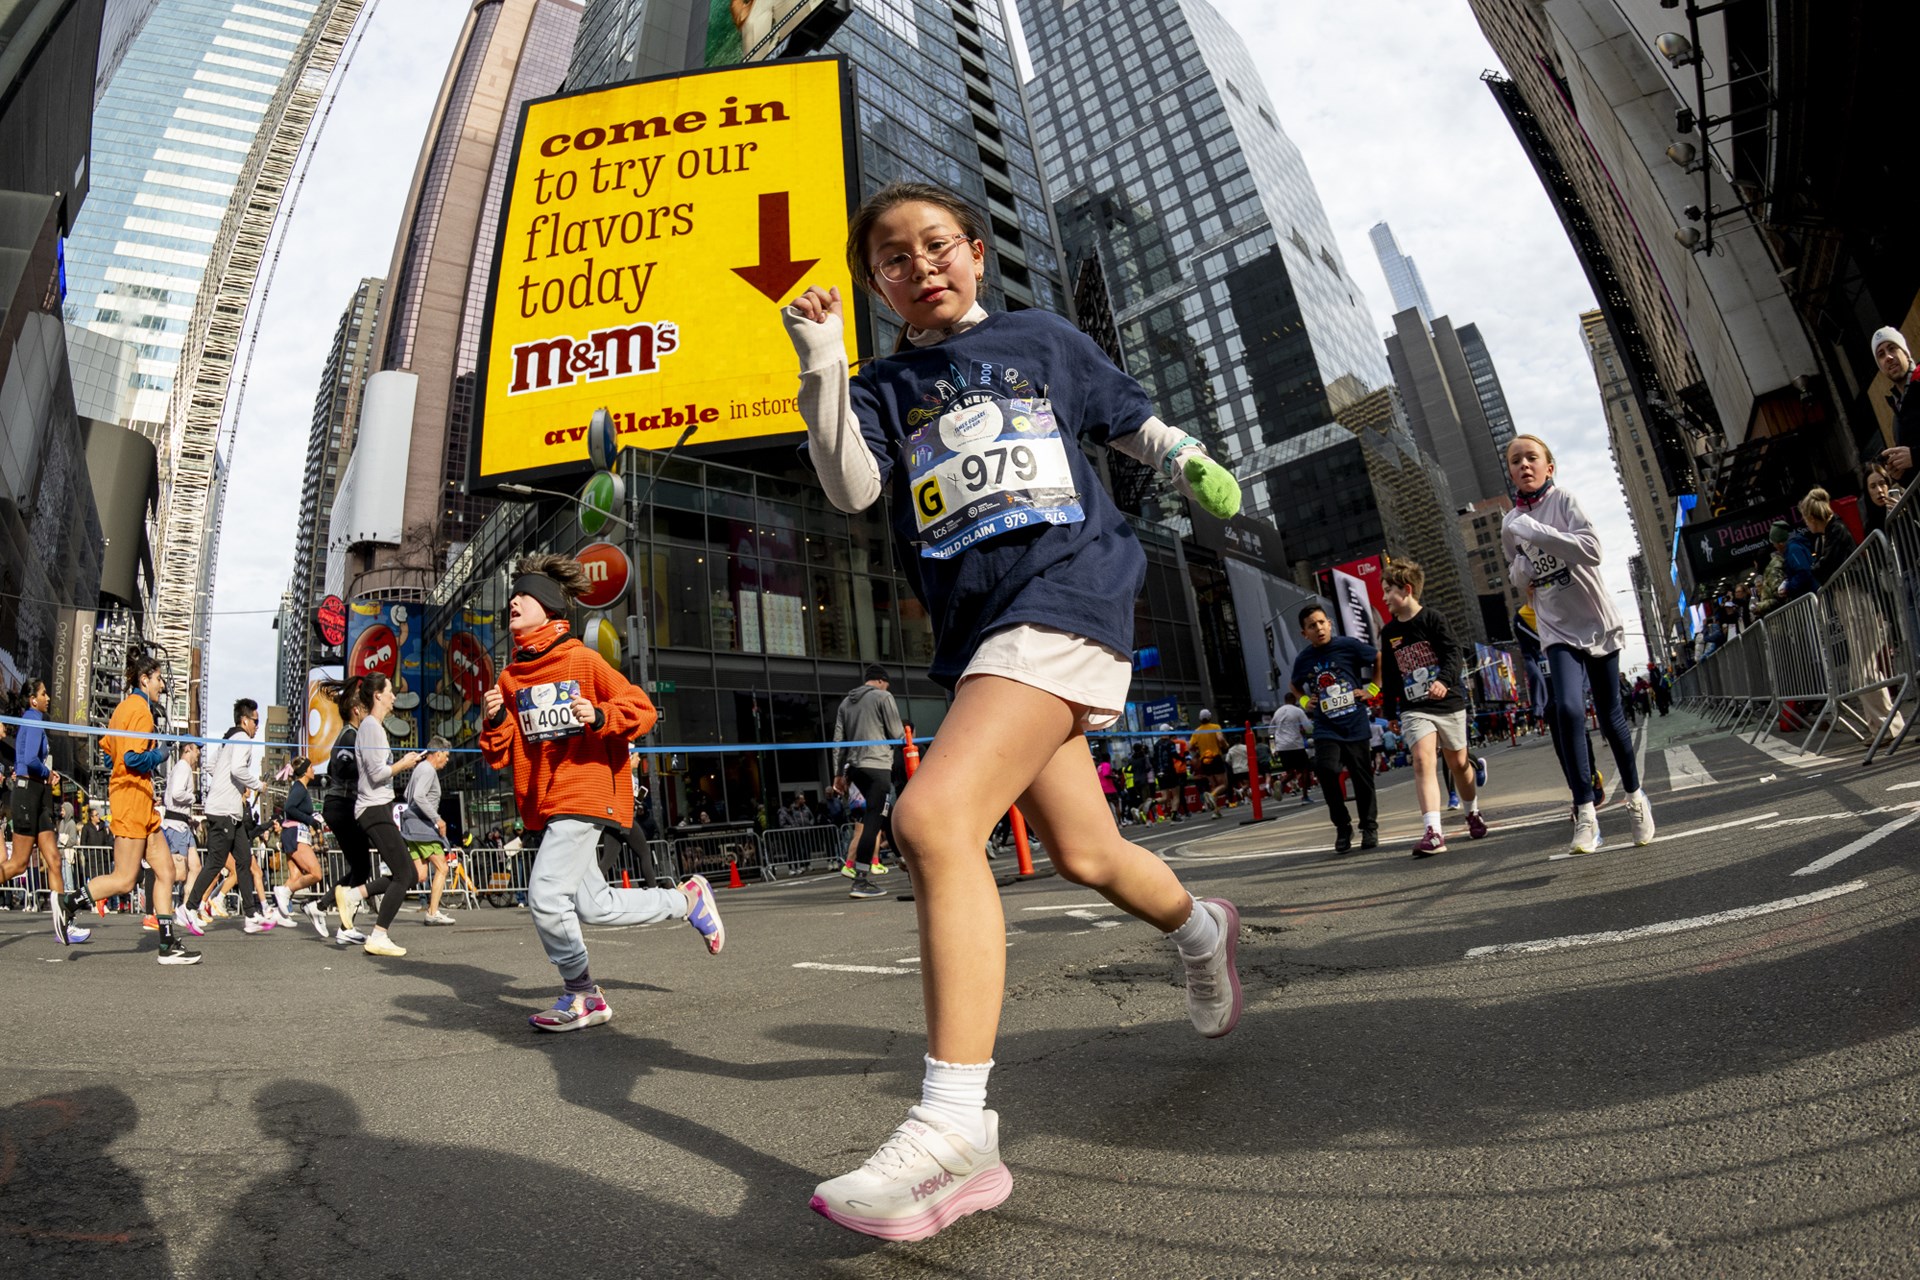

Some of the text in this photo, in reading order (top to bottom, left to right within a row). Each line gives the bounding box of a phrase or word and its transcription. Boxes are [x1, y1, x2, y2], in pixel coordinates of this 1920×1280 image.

[540, 96, 790, 158] come in
[534, 141, 758, 205] to try our
[522, 201, 694, 263] flavors
[518, 257, 658, 319] today
[964, 395, 992, 406] NEW
[544, 404, 719, 446] avilable
[730, 400, 747, 420] in
[918, 480, 944, 517] G
[962, 445, 1037, 492] 979
[962, 523, 996, 546] CLAIM
[1004, 512, 1028, 529] 979
[584, 560, 608, 582] m
[77, 624, 92, 702] Olive Garden
[1322, 695, 1348, 710] G 978
[1407, 687, 1415, 698] H
[522, 707, 570, 732] H 400
[165, 925, 171, 937] 1
[910, 1170, 954, 1202] HOKA
